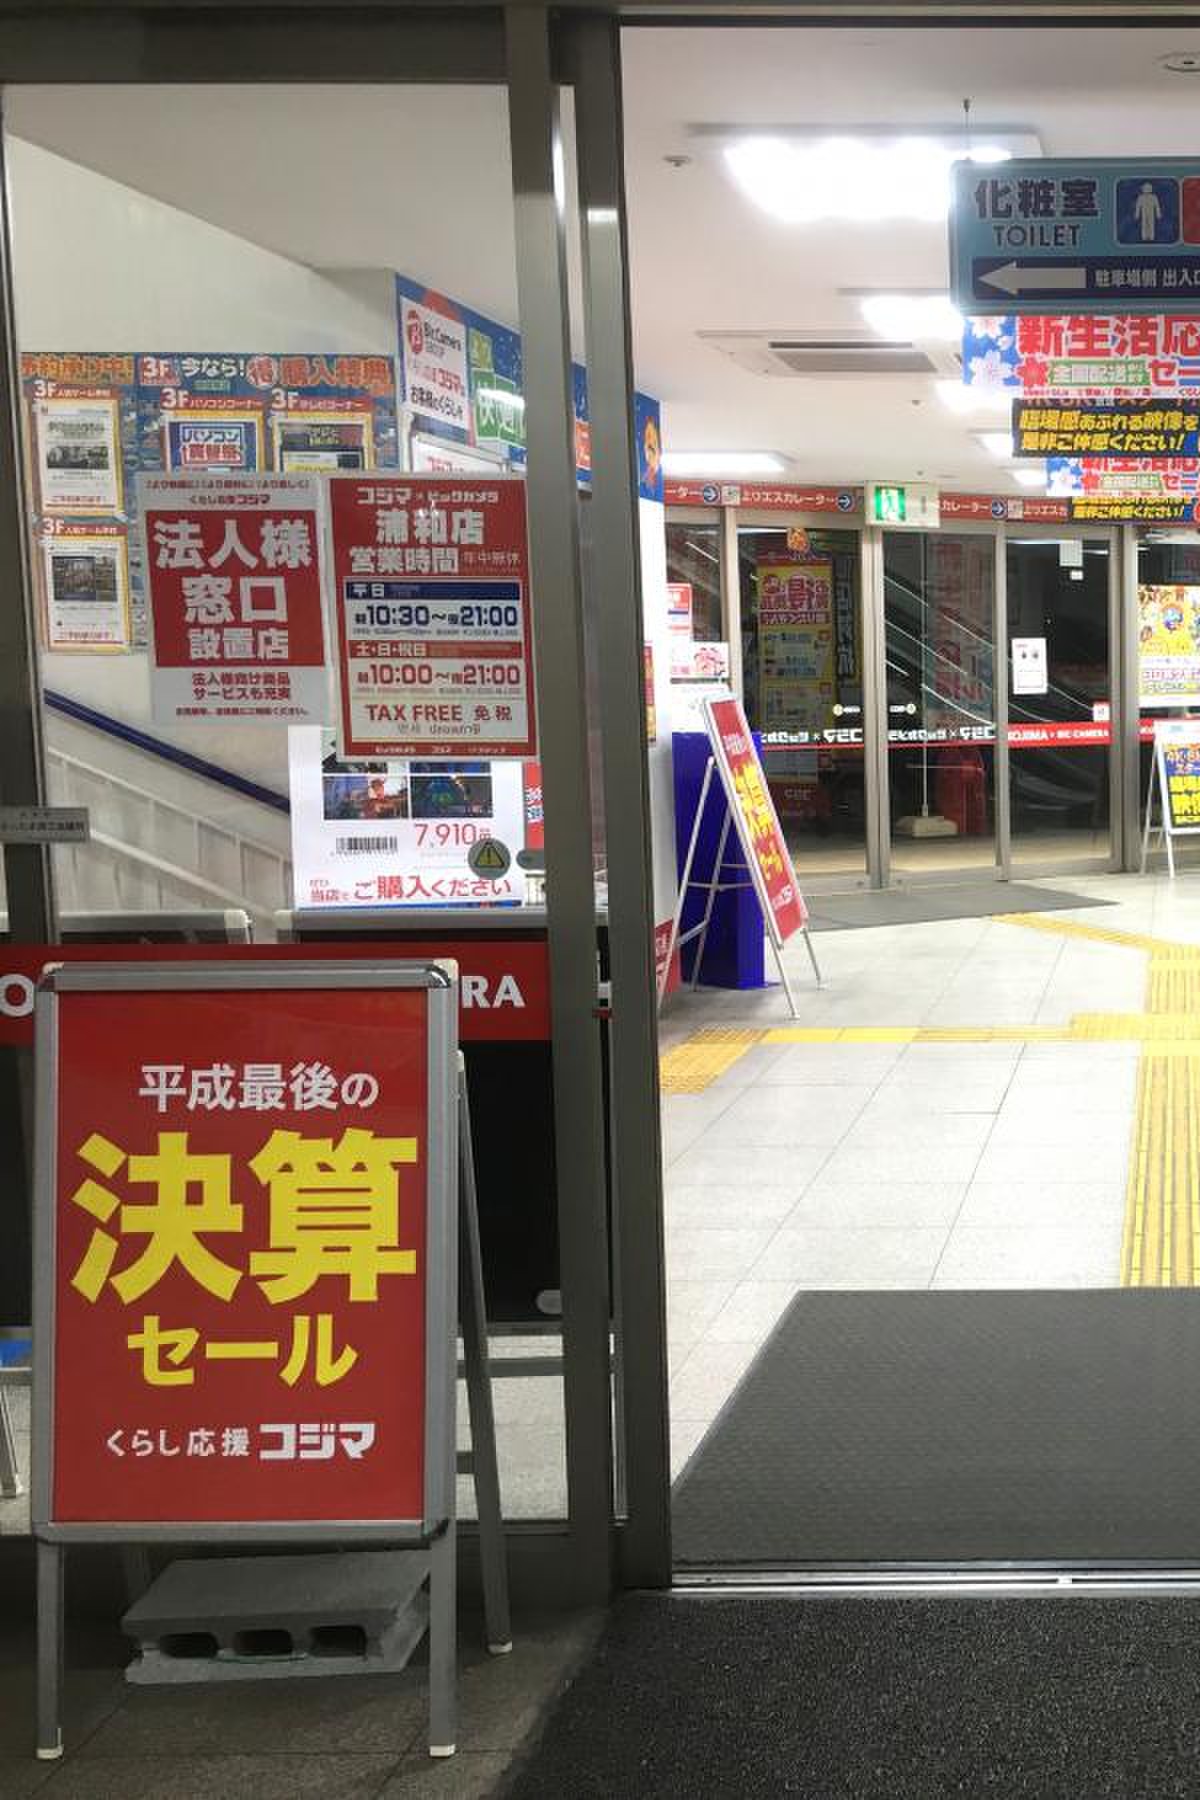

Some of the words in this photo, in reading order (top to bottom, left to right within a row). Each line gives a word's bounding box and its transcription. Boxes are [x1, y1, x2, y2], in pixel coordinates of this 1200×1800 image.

[973, 179, 1100, 219] 化粧室
[993, 224, 1081, 248] TOILET
[1095, 268, 1158, 288] 駐車場側
[153, 518, 314, 570] 法人様
[375, 508, 485, 546] 浦和店
[349, 547, 460, 575] 営業時間
[181, 572, 289, 625] 窓口
[352, 583, 386, 598] 平日
[187, 627, 290, 662] 設置店
[366, 704, 407, 721] TAX
[412, 704, 464, 721] FREE
[473, 703, 513, 722] 免税
[415, 823, 477, 848] 7,910
[354, 876, 512, 899] ご購入ください
[139, 1063, 379, 1113] 平成最後の
[71, 1127, 418, 1305] 決算
[127, 1314, 359, 1387] セール
[106, 1427, 250, 1458] くらし応援
[259, 1423, 376, 1461] コジマ
